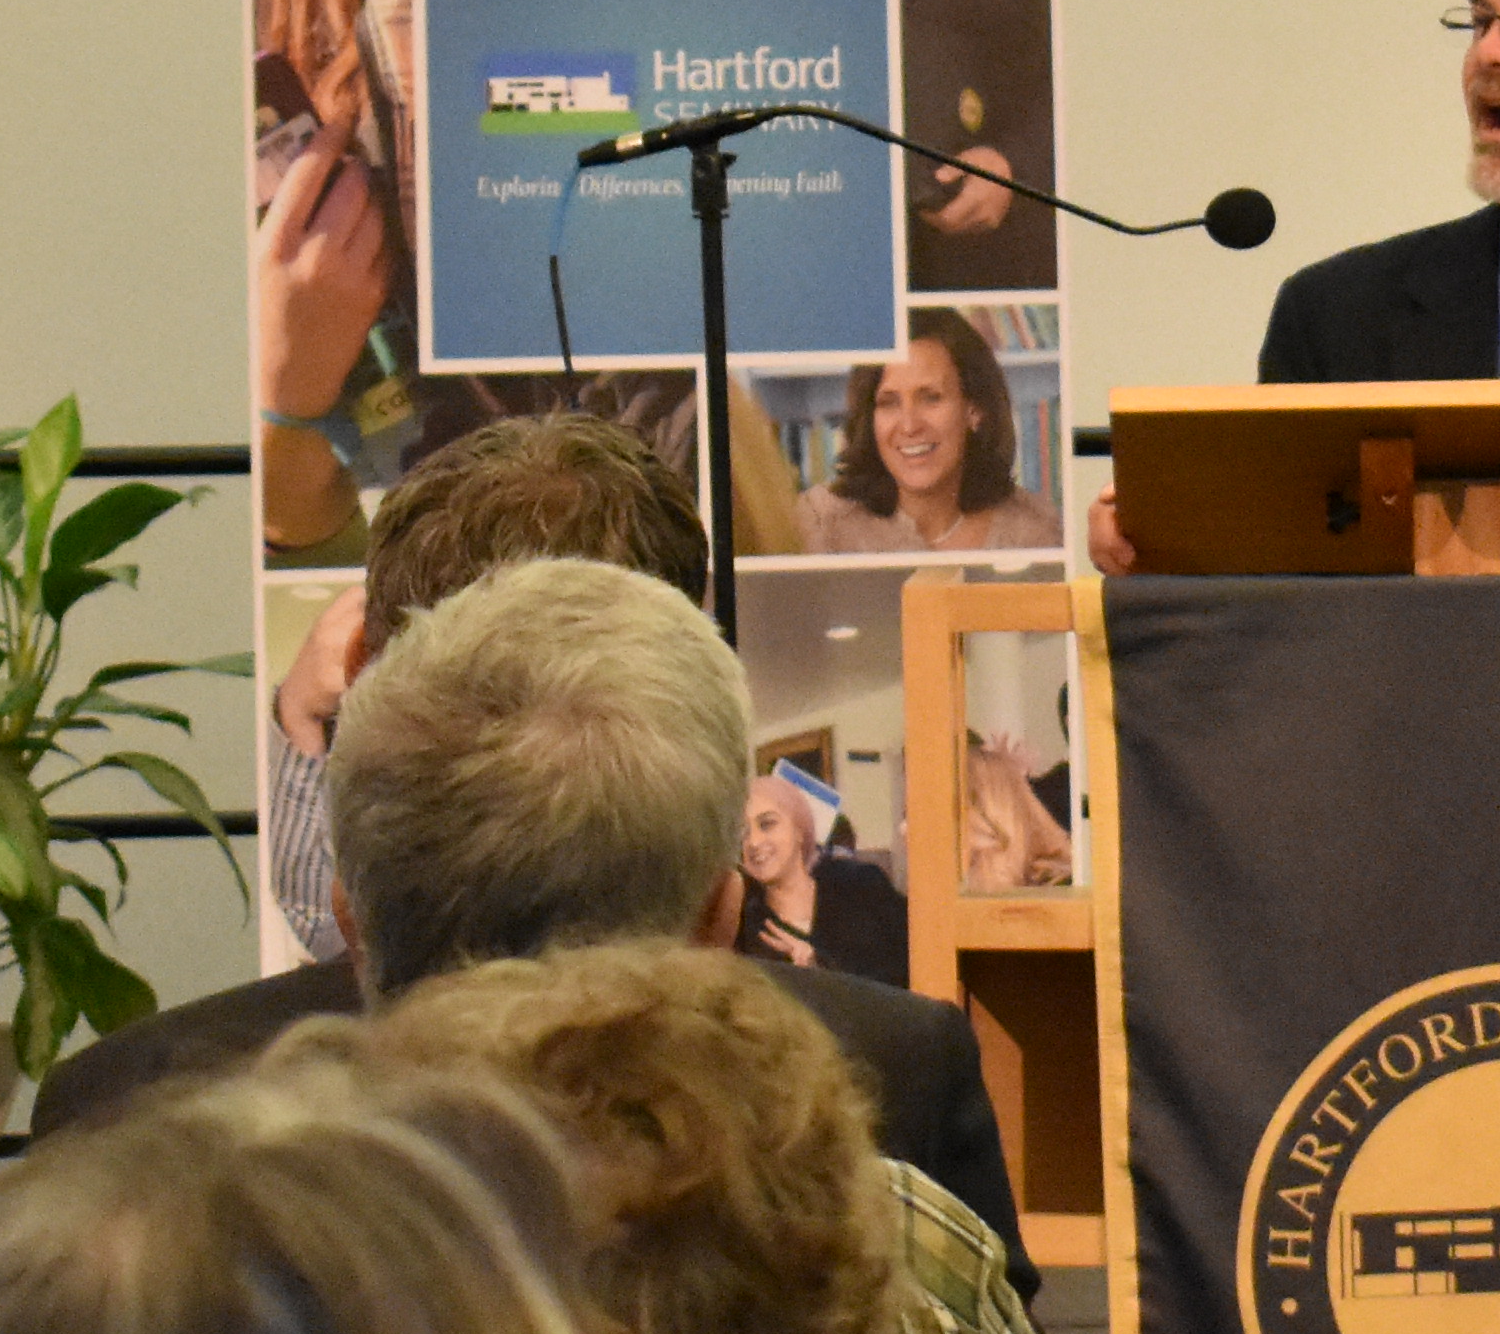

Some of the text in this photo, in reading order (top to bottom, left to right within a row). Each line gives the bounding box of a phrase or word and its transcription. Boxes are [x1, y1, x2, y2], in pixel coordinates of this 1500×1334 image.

[653, 45, 842, 91] Hartford
[477, 175, 563, 204] Explorin
[797, 170, 843, 193] Faith
